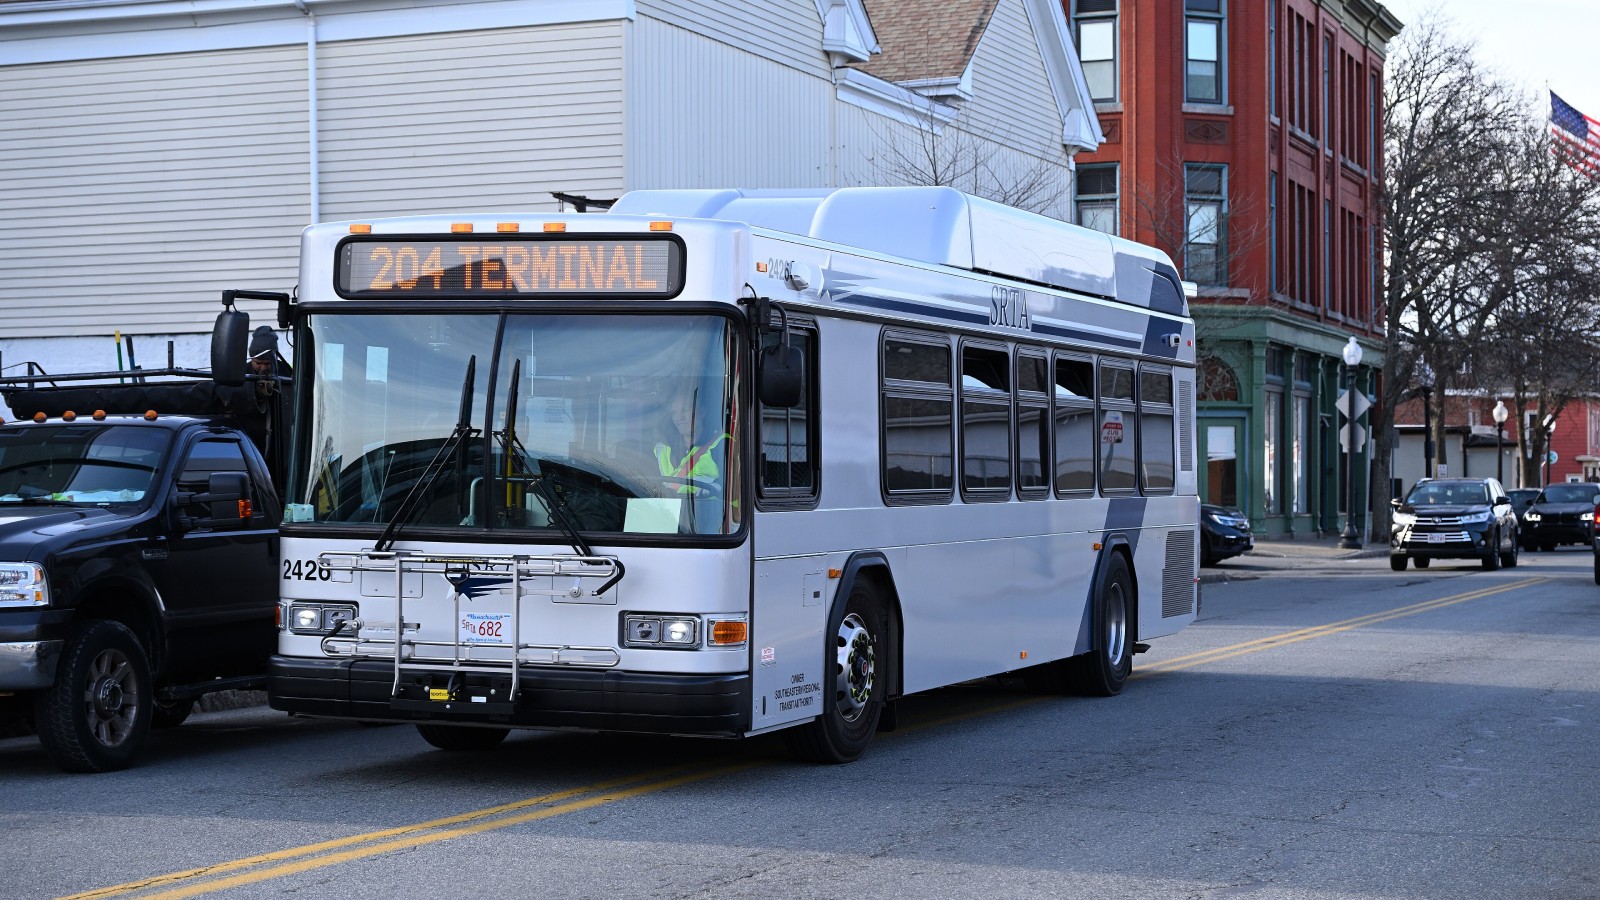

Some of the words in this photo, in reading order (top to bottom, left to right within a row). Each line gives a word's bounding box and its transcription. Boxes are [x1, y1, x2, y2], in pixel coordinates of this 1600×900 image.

[370, 246, 444, 289] 204
[458, 245, 657, 289] TERMINAL
[990, 284, 1030, 330] SRTA
[283, 559, 331, 581] 2426
[479, 621, 502, 637] 682
[791, 673, 804, 684] OWNER
[775, 685, 803, 699] SOUTHEASTERN
[803, 682, 820, 694] REGIONAL
[779, 699, 794, 711] TRANSIT
[794, 696, 814, 708] AUTHORITY
